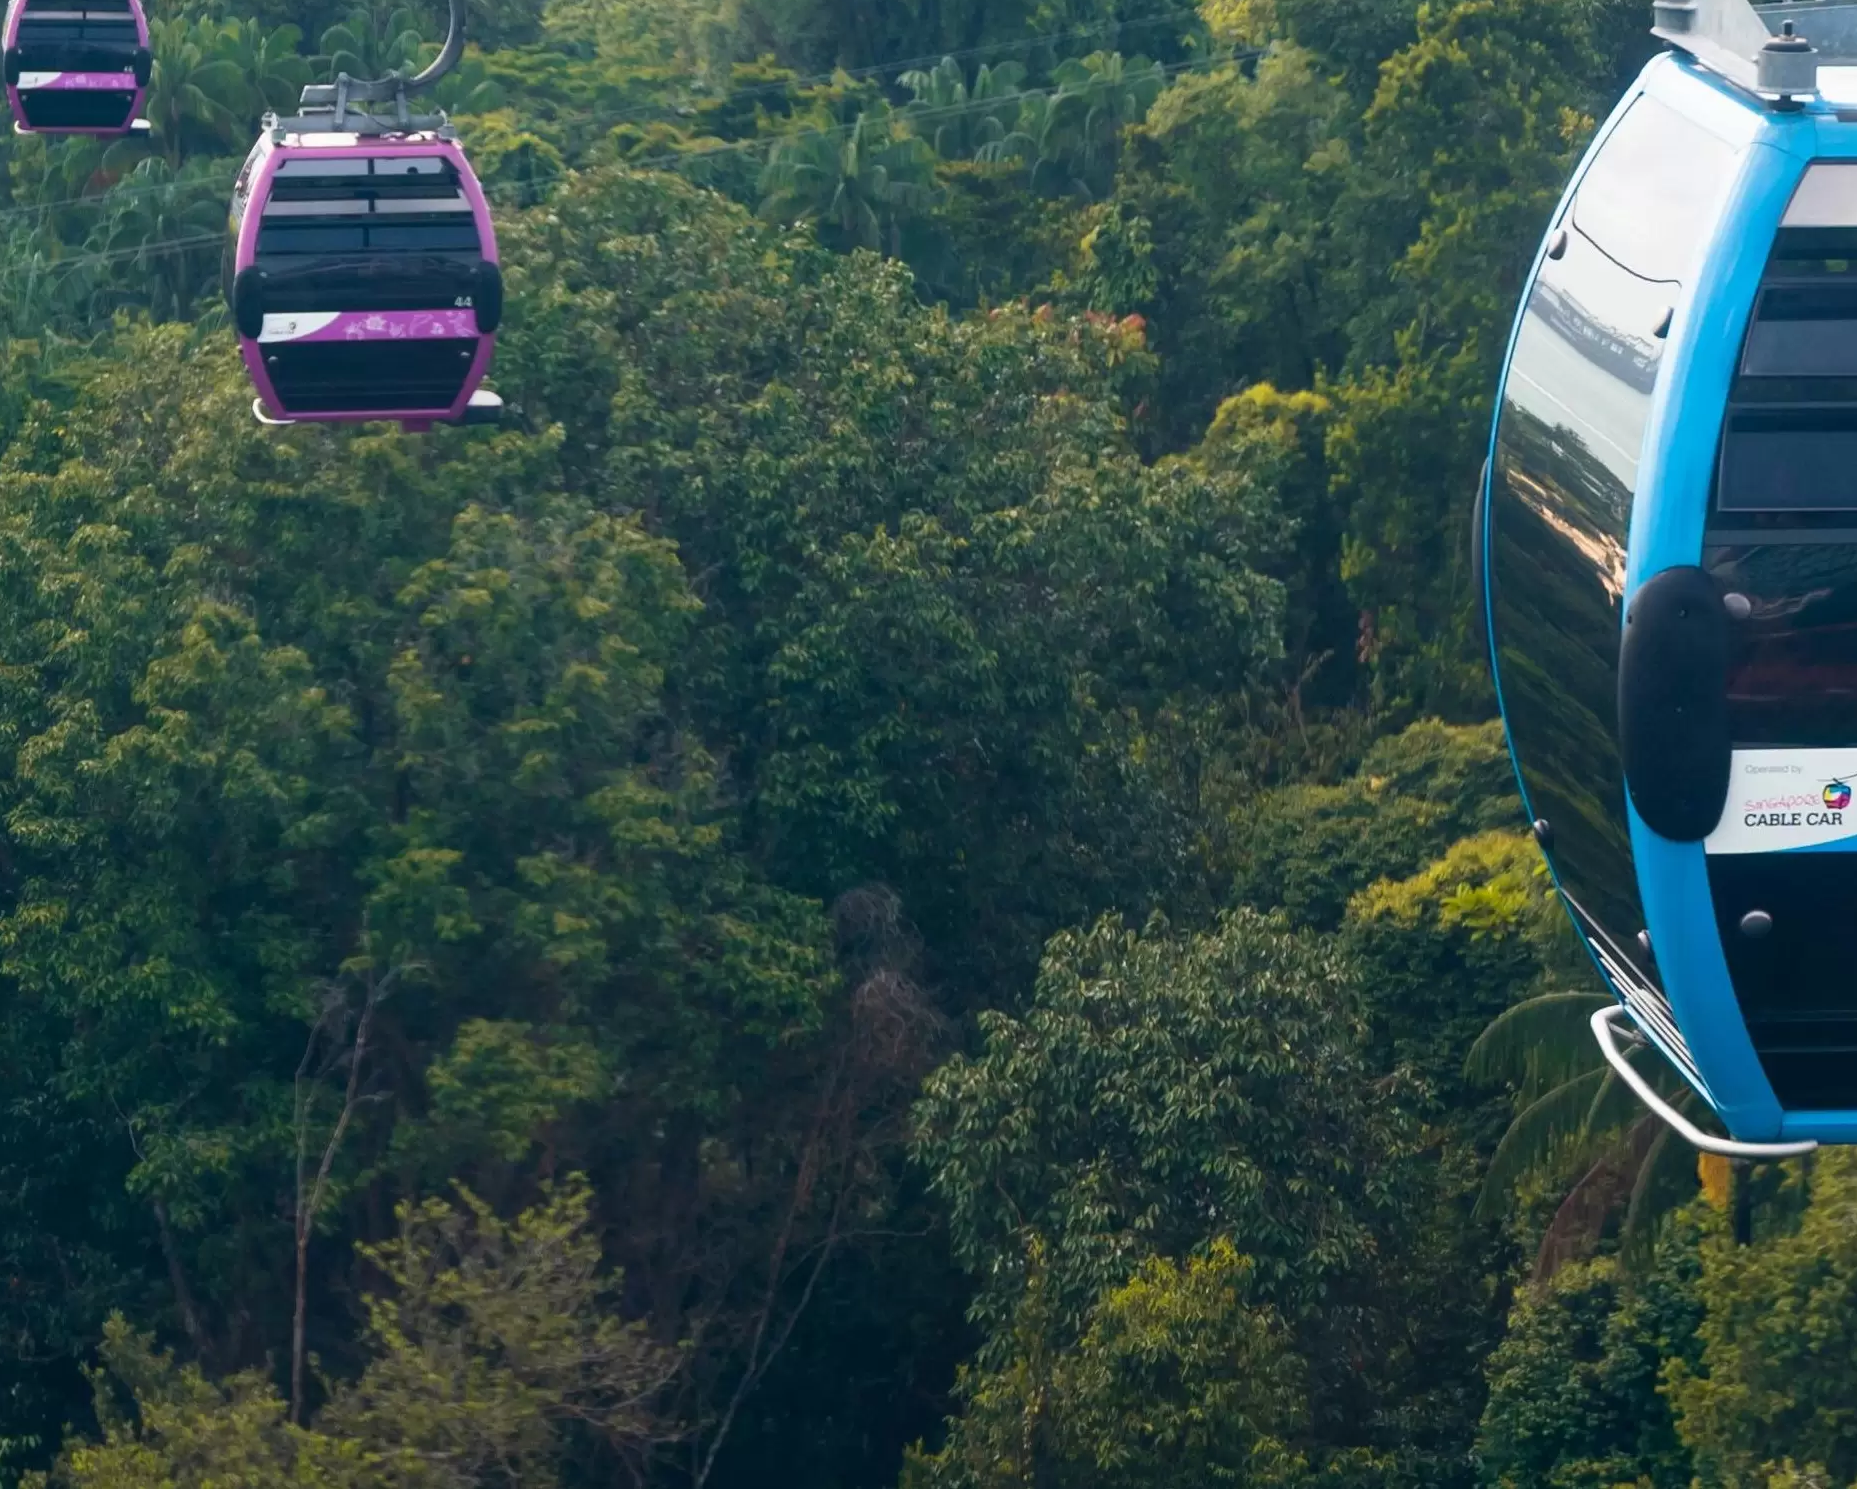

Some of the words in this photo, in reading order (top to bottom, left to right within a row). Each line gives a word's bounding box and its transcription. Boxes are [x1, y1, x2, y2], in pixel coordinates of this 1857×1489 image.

[454, 296, 473, 307] 44
[1744, 813, 1802, 827] CABLE
[1806, 812, 1843, 826] CAR
